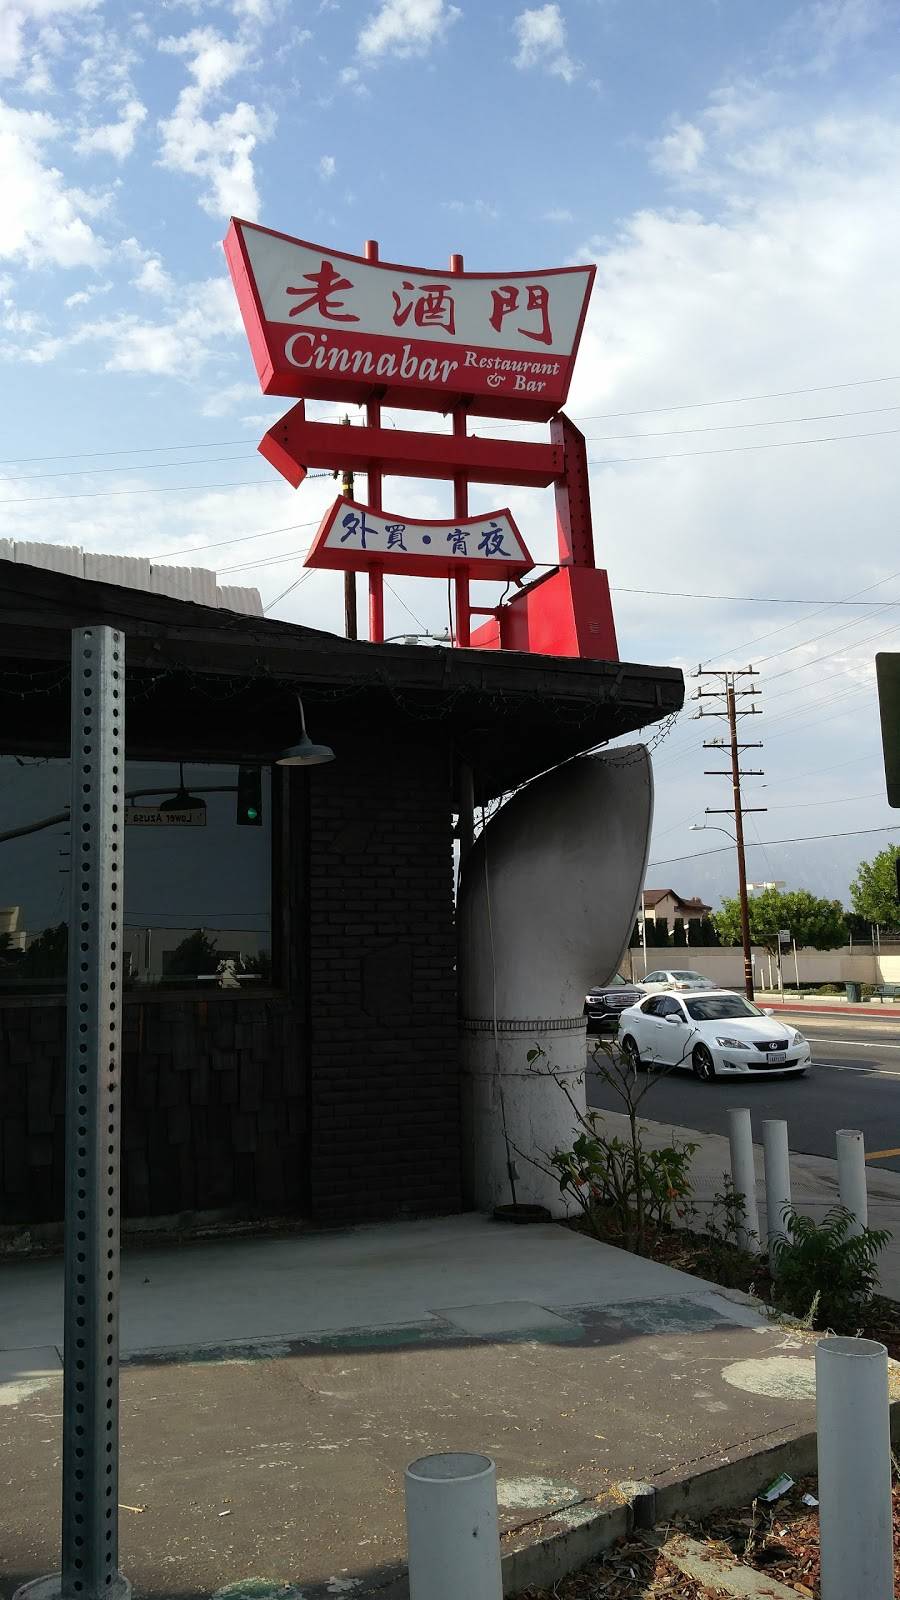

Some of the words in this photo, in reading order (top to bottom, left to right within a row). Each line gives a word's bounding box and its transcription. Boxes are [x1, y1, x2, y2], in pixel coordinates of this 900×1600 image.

[286, 260, 553, 346] 老酒門
[284, 332, 459, 383] Cinnabar
[463, 351, 561, 376] Restaurant
[486, 372, 506, 388] &
[513, 374, 547, 393] Bar
